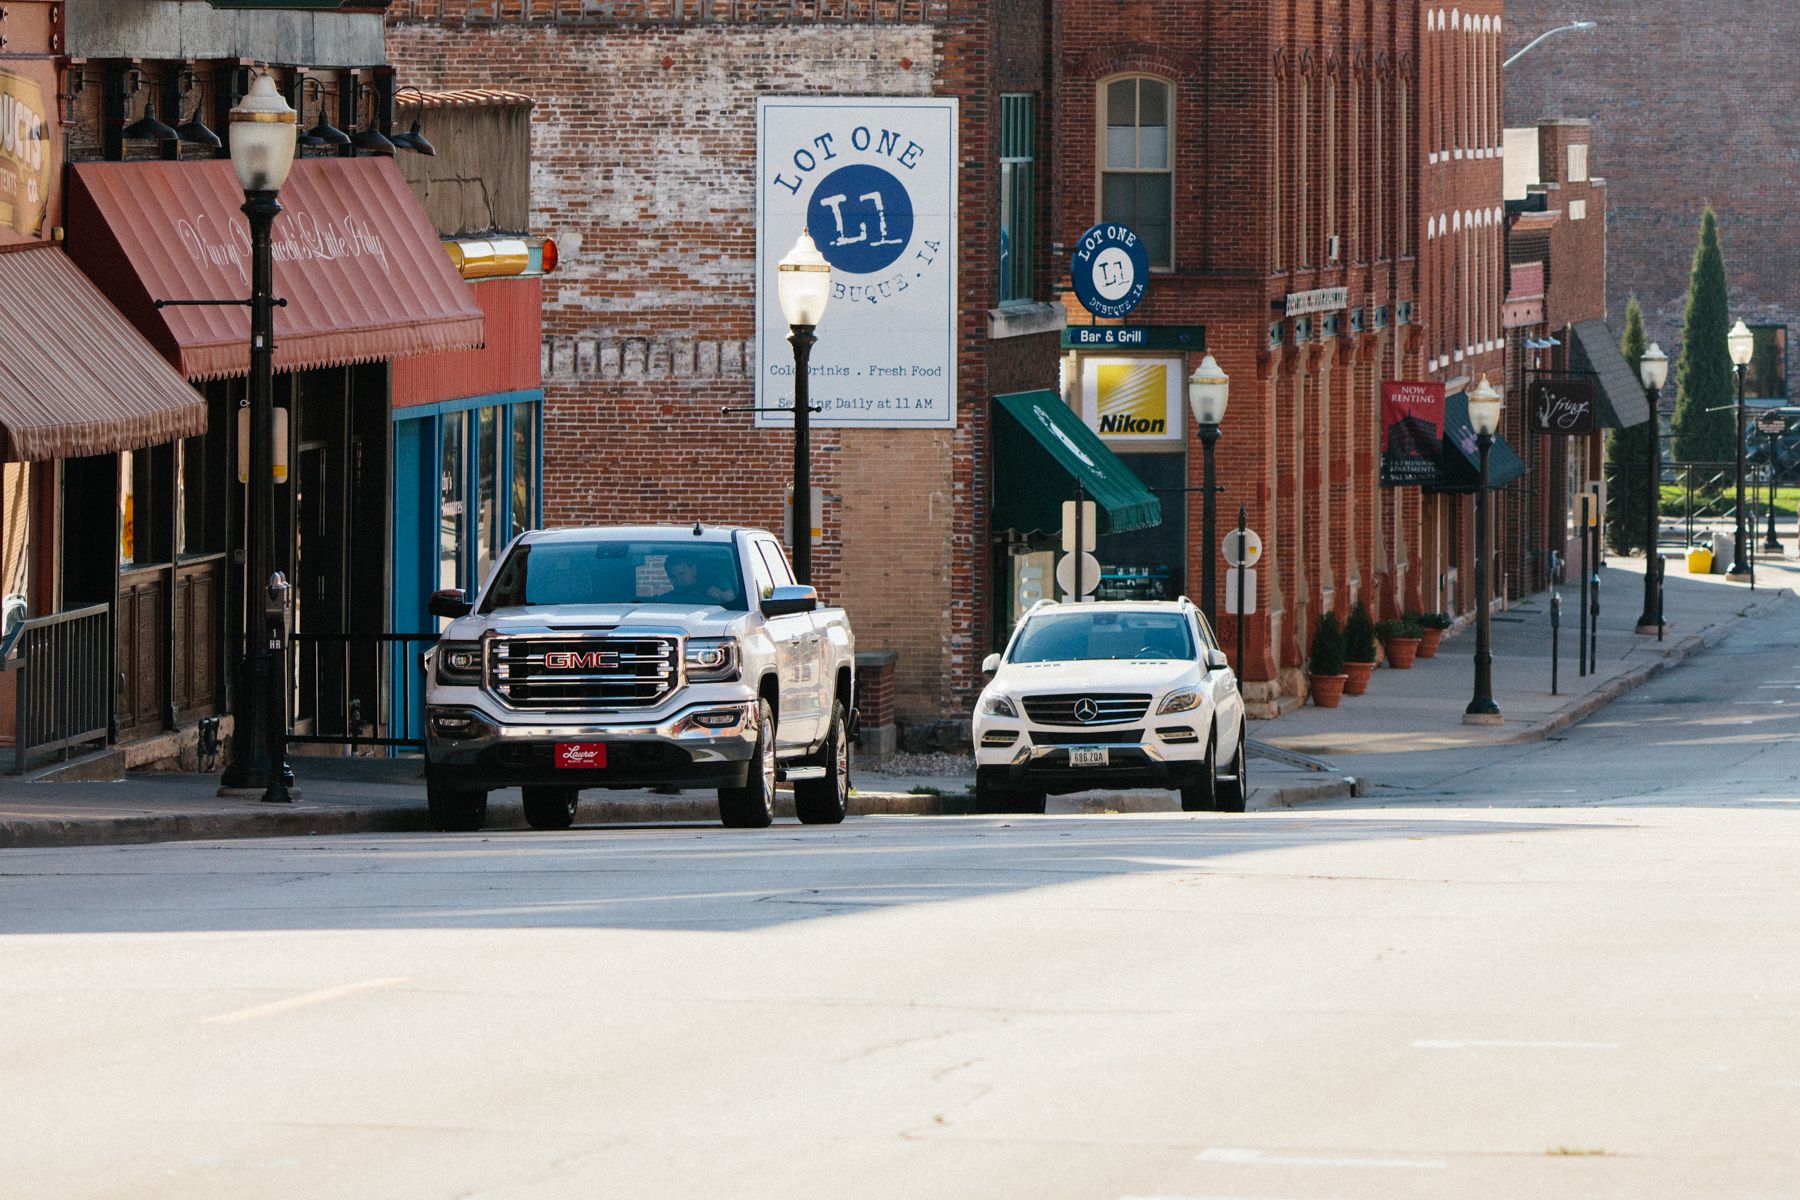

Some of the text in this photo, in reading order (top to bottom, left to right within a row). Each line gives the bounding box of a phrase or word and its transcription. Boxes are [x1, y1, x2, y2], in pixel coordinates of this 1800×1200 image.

[0, 93, 41, 171] UCTS
[774, 126, 924, 195] LOT ONE
[1078, 226, 1136, 261] LOT ONE
[831, 239, 941, 304] BUQUE IA
[1089, 297, 1131, 316] DUBUQUE
[1080, 330, 1141, 342] Bar & Grill
[869, 365, 907, 376] Fresh
[911, 366, 942, 376] Food
[1401, 386, 1426, 394] NOW
[778, 398, 832, 410] Seing
[836, 398, 872, 411] Daily
[877, 399, 890, 409] at
[915, 399, 933, 408] AM
[1391, 394, 1435, 404] RENTING
[1548, 397, 1590, 428] fringe
[1099, 415, 1164, 433] Nikon
[272, 628, 277, 638] 1
[269, 639, 281, 649] HR
[545, 651, 619, 668] GMC
[563, 745, 598, 760] Laura
